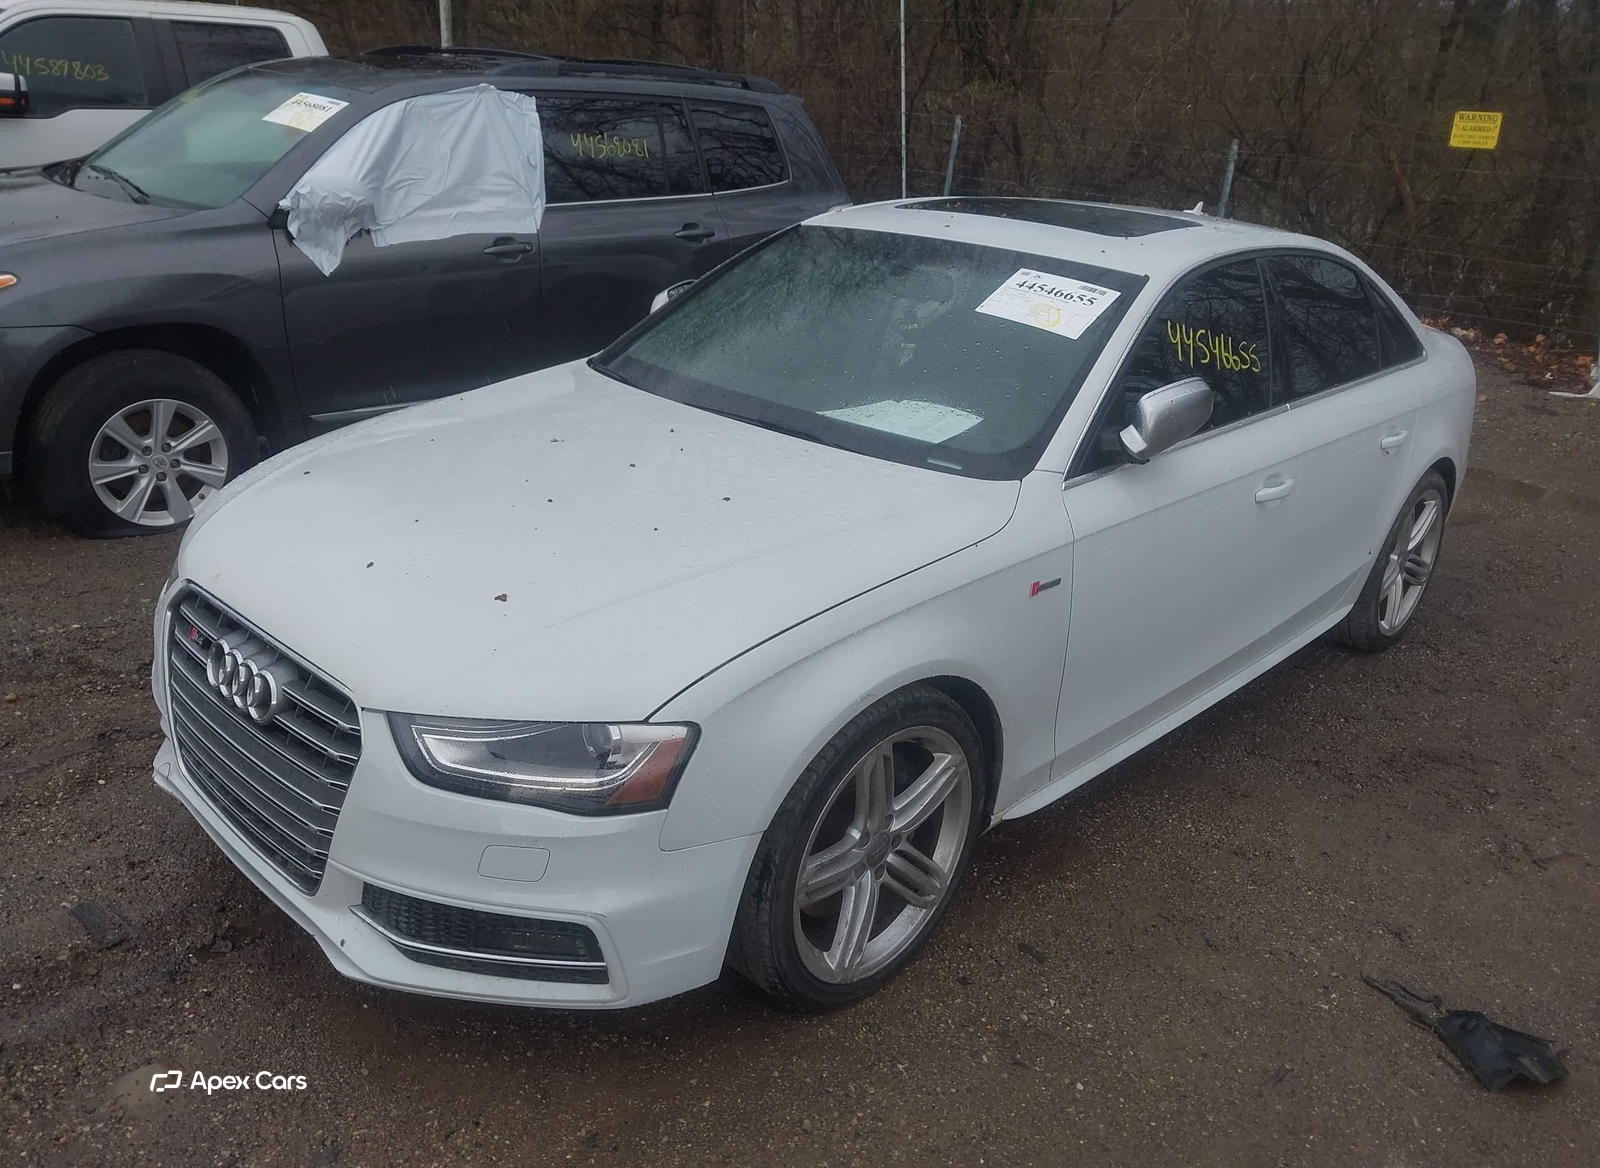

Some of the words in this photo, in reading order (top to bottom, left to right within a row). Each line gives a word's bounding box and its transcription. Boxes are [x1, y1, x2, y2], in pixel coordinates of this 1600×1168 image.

[2, 50, 109, 80] 44589803
[1459, 113, 1499, 123] WARNING
[1460, 124, 1492, 133] ALARMED
[570, 132, 650, 159] 44568081
[1015, 280, 1098, 307] 44546655
[1167, 320, 1261, 373] 44546655
